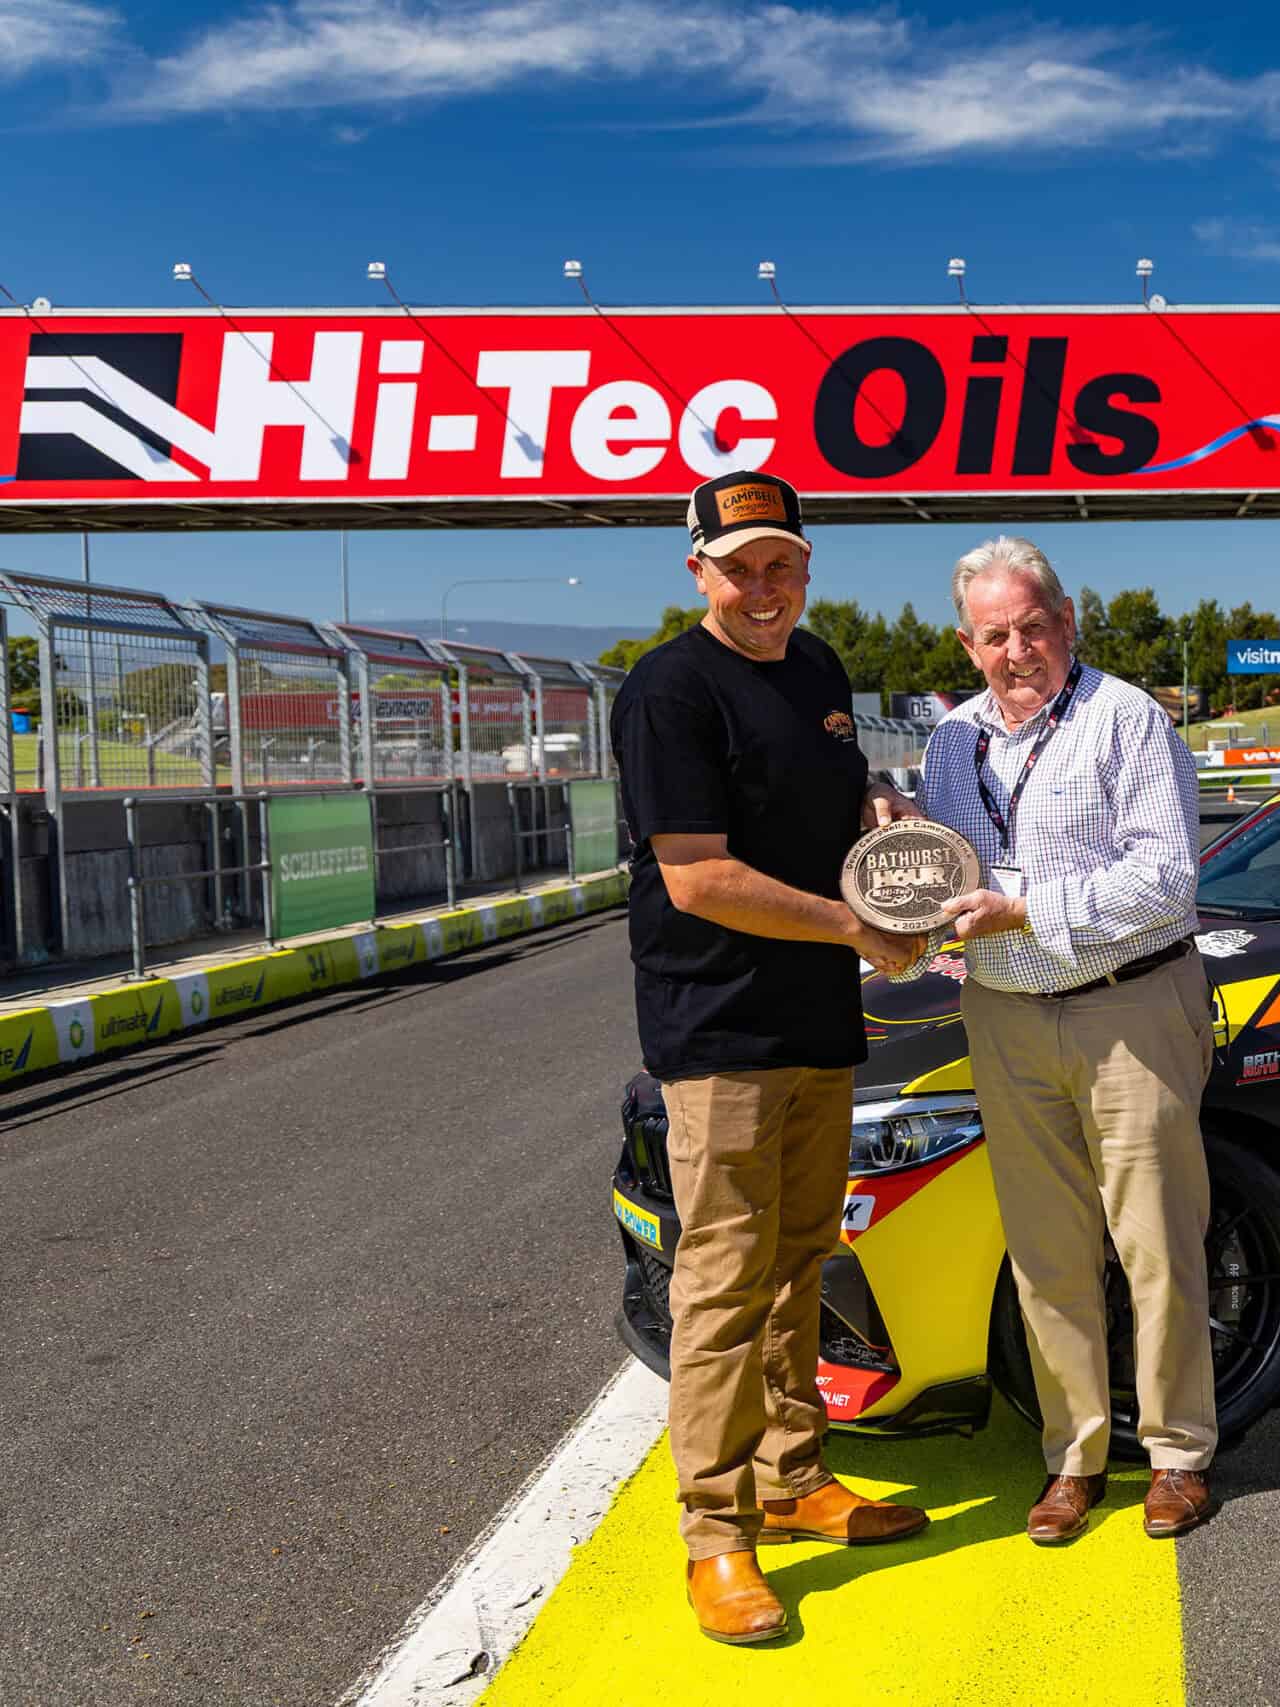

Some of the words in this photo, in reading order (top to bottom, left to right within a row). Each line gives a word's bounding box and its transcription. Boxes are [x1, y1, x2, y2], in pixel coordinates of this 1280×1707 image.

[209, 331, 778, 481] Hi-Tec
[813, 336, 1162, 479] Oils
[911, 701, 932, 719] 05
[280, 846, 369, 882] SCHAEFFLER
[866, 848, 953, 869] BATHURST
[902, 921, 929, 931] 2025
[216, 983, 254, 1007] ultimate
[100, 1009, 148, 1039] ultimate
